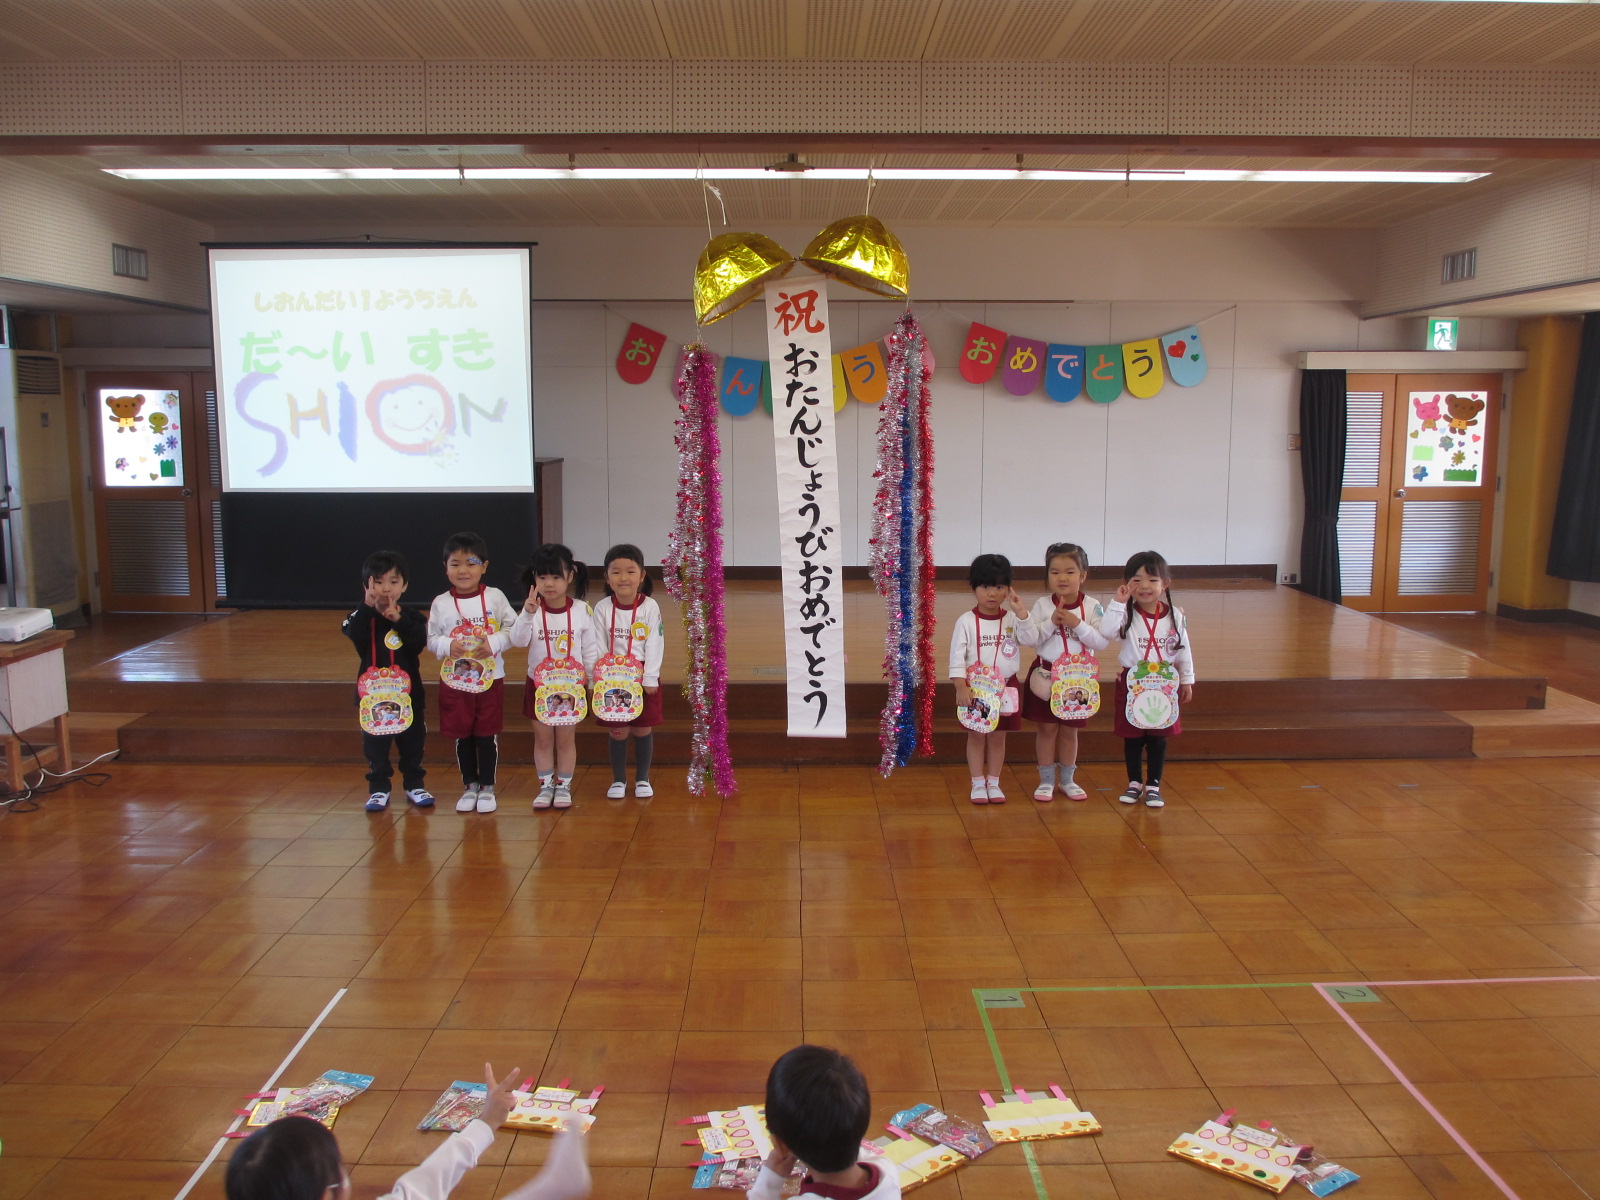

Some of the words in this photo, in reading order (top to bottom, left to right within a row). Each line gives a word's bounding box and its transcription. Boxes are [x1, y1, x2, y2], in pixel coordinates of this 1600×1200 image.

[773, 289, 825, 335] 祝
[407, 328, 496, 371] すき
[966, 336, 1154, 381] おめでとう
[233, 371, 508, 478] SHION
[783, 342, 837, 729] おたんじょうびおめでとう
